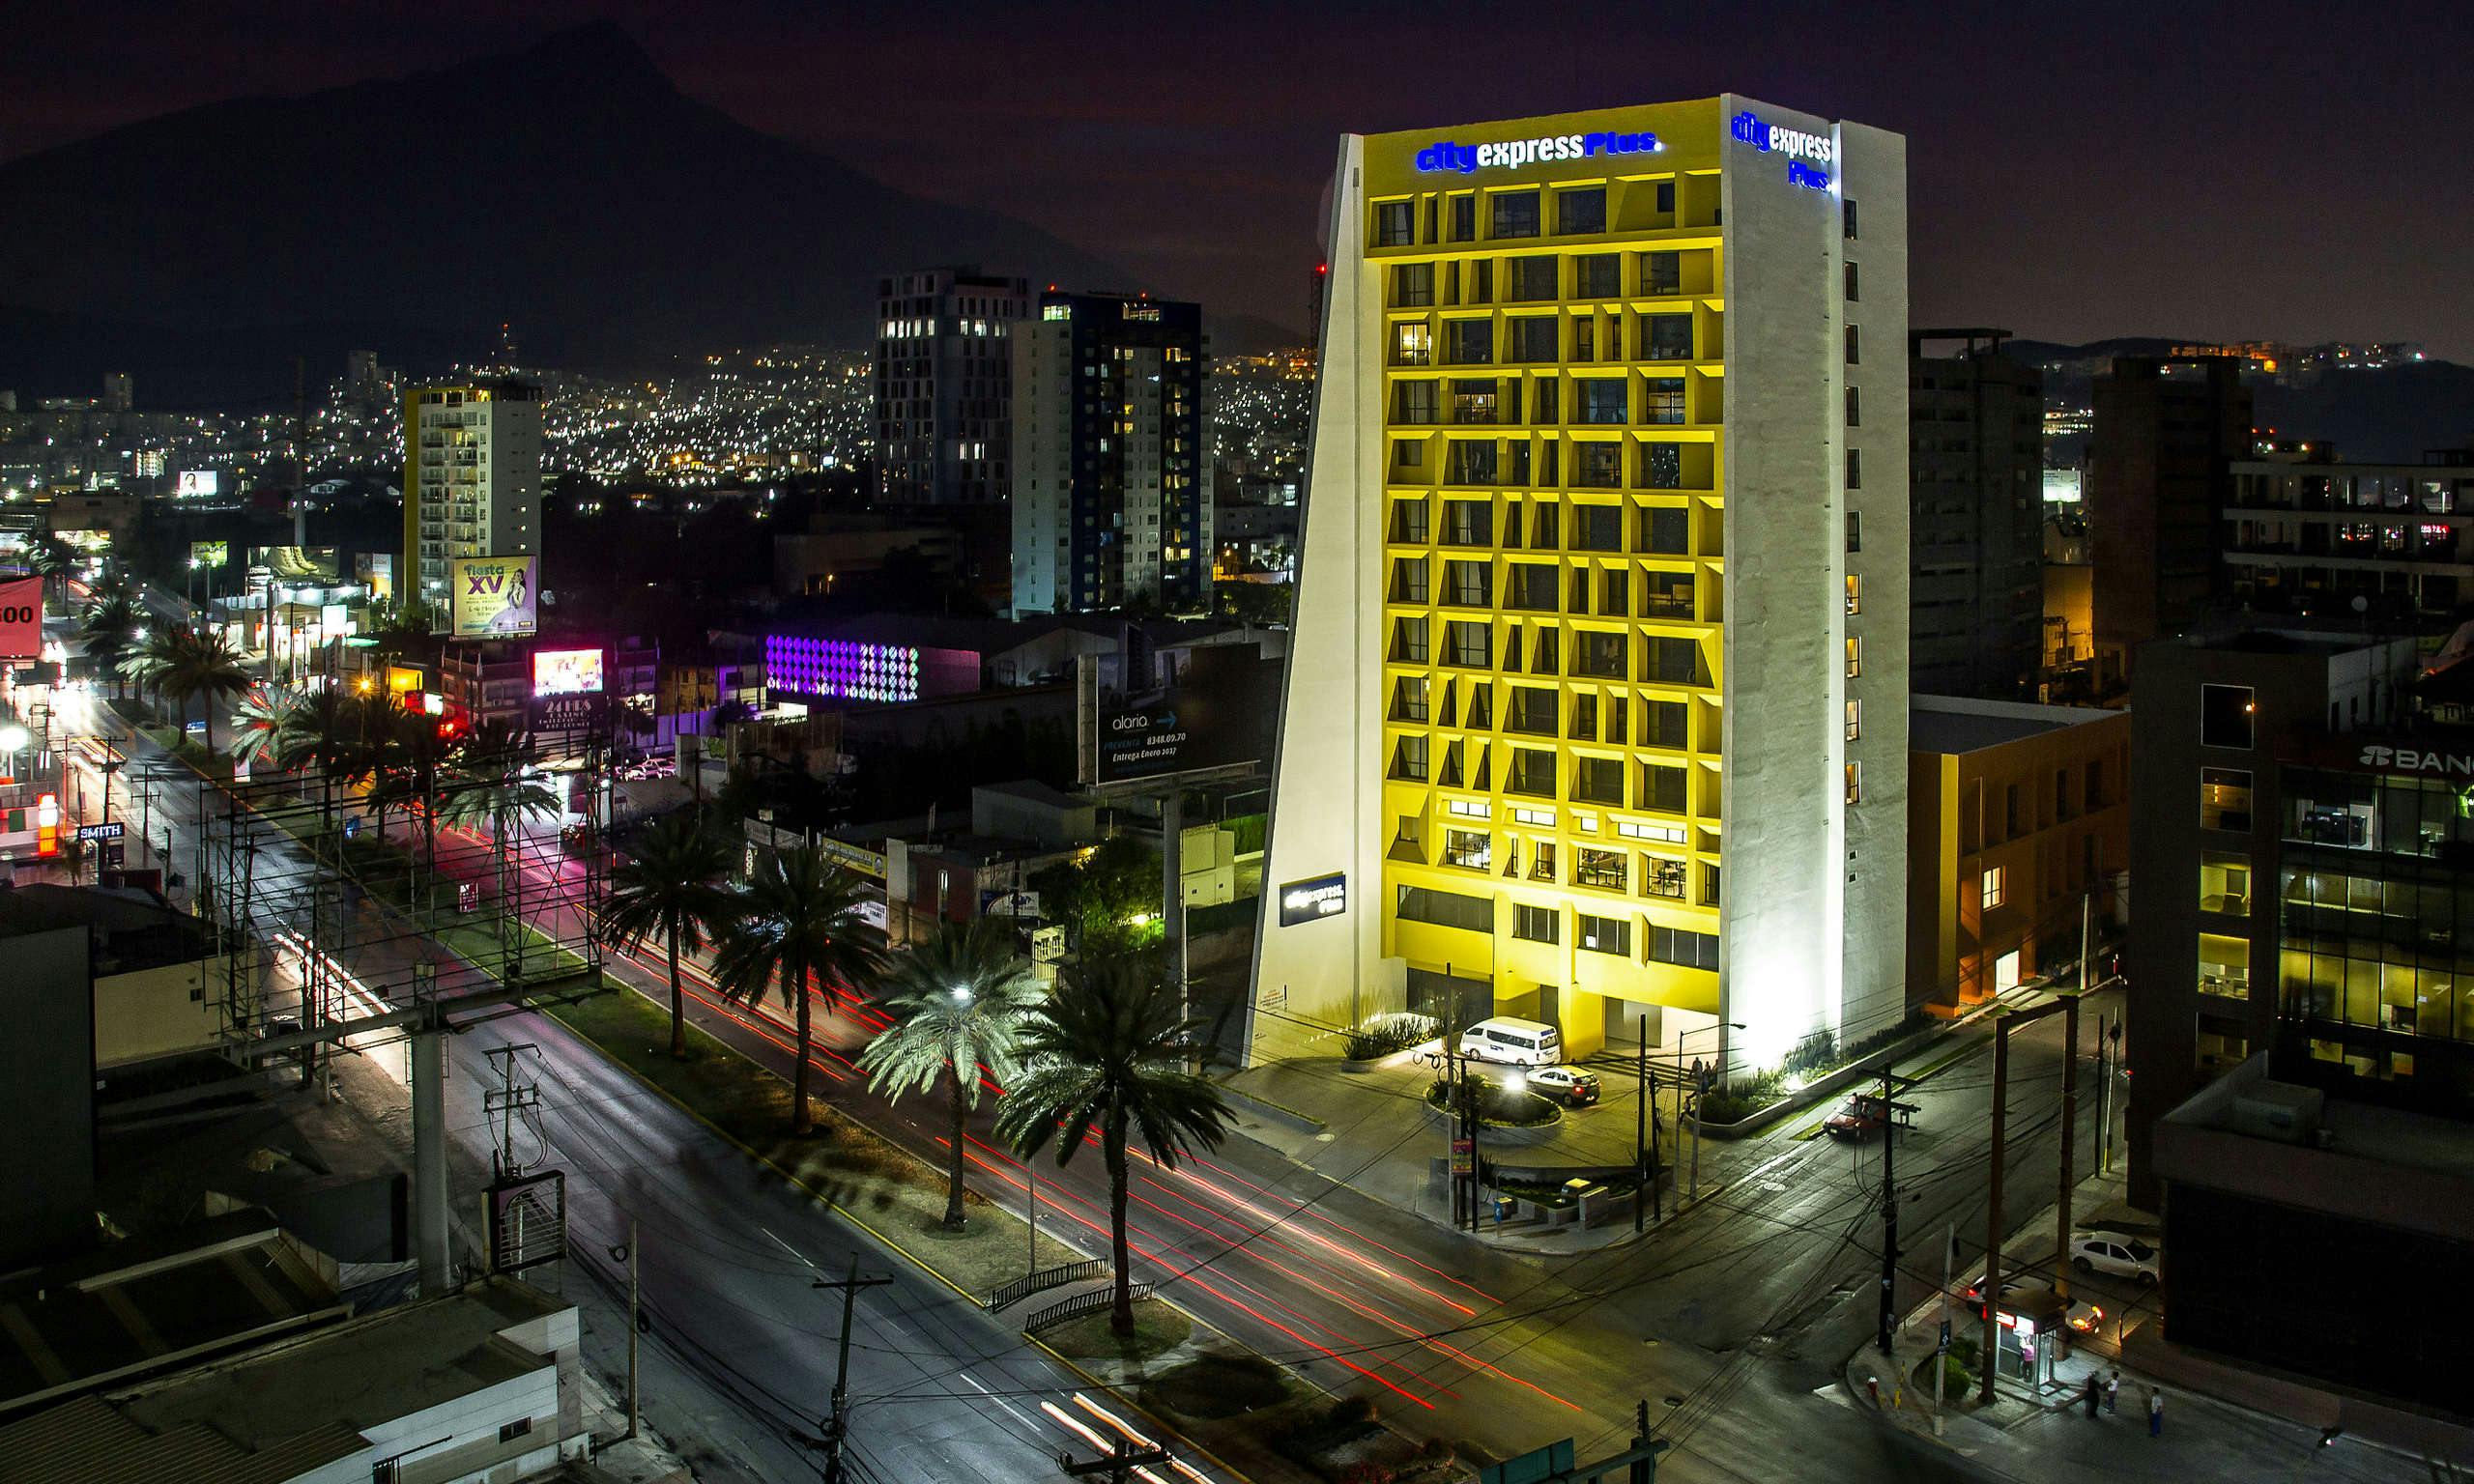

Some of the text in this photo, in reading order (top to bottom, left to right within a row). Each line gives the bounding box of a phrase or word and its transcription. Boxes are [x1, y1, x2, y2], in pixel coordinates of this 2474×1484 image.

[468, 575, 503, 594] XV
[0, 606, 33, 624] 00
[2396, 749, 2474, 775] BAN
[80, 824, 121, 839] SMITH
